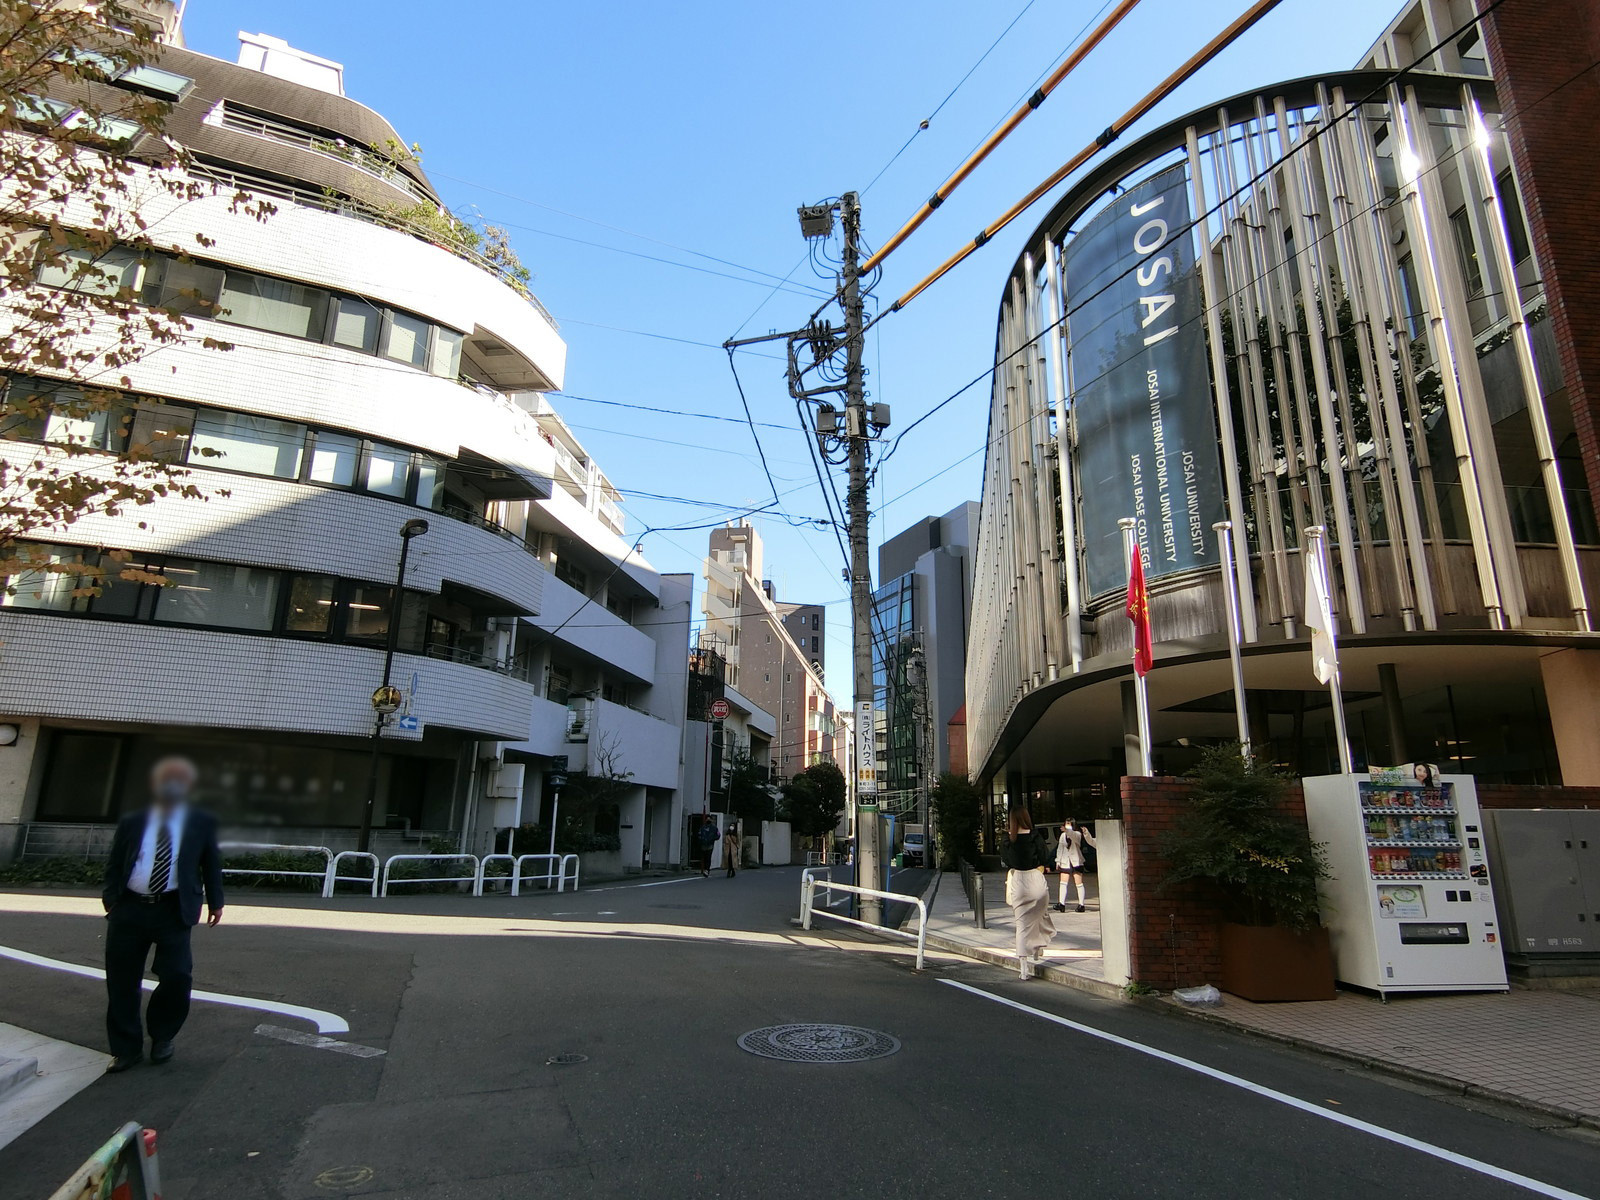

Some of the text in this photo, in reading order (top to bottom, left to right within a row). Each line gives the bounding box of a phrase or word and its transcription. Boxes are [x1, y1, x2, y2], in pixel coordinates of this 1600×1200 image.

[1131, 196, 1179, 346] JOSAI
[1131, 454, 1151, 570] JOSAI BASE COLLEGE
[1147, 369, 1177, 562] JOSAI INTERNATIONAL UNIVERSITY
[1182, 451, 1205, 556] JOSAI UNIVERSITY
